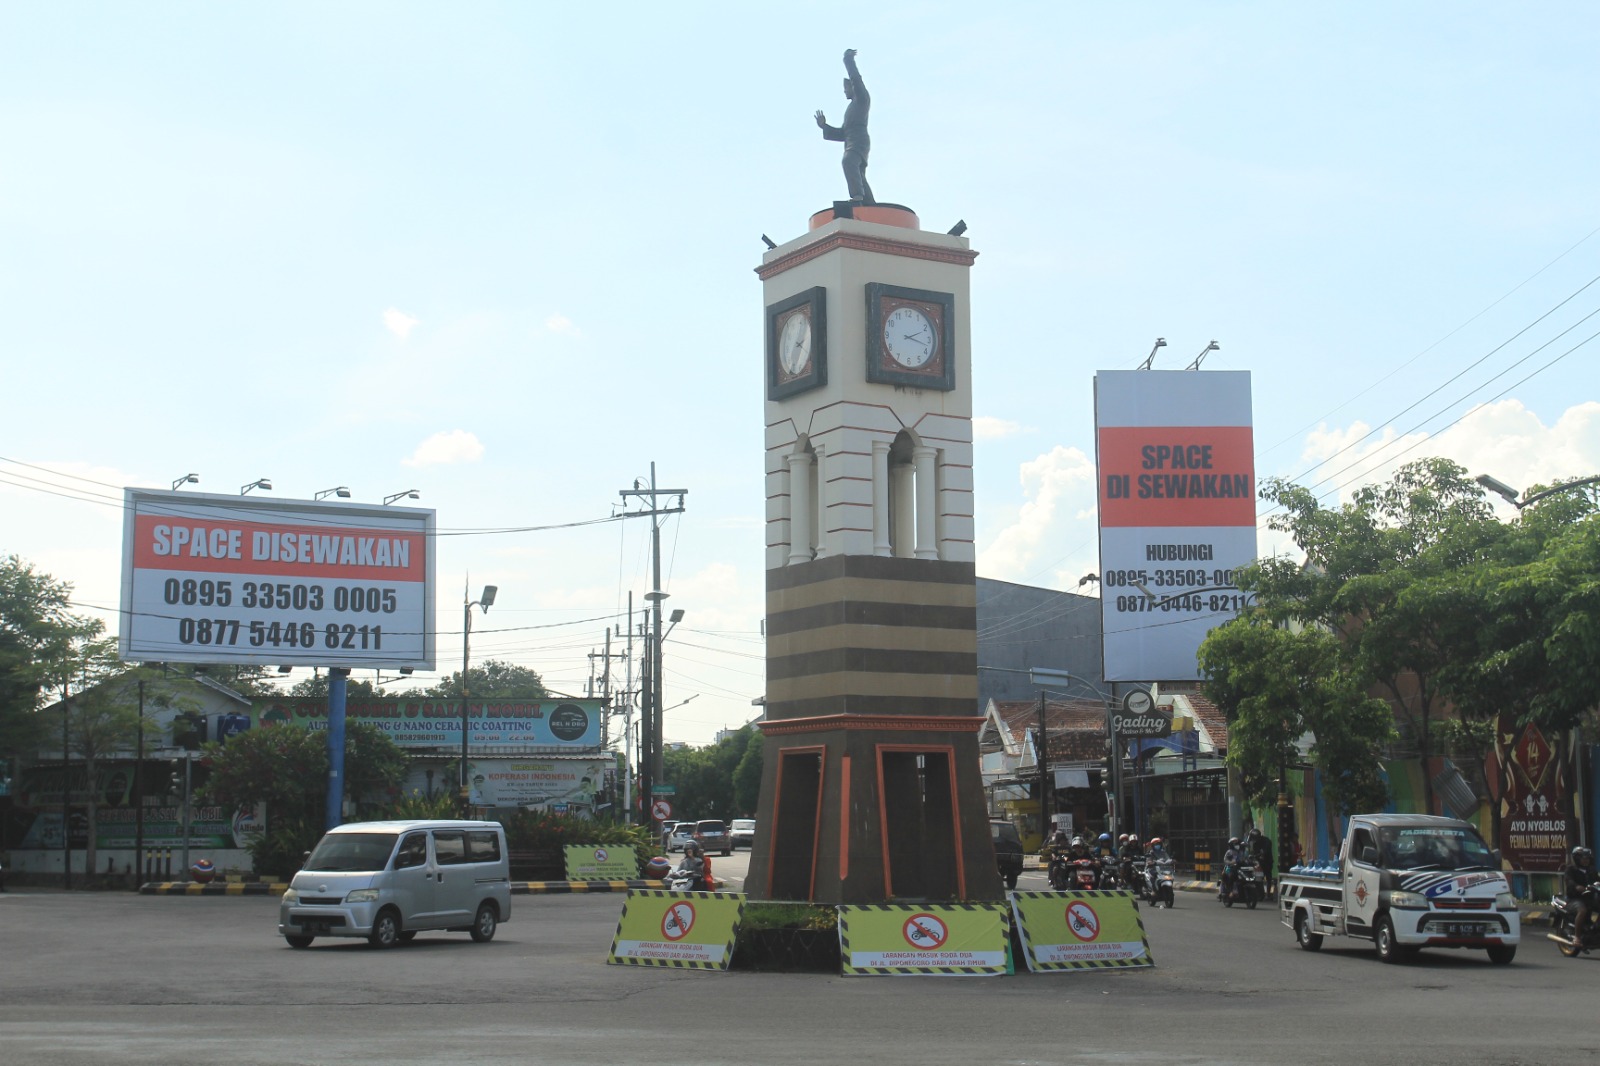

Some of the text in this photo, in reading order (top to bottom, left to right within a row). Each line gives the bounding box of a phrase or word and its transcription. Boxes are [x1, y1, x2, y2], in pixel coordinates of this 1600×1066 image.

[895, 312, 901, 320] 11
[904, 310, 912, 318] 12
[888, 319, 895, 328] 10
[923, 324, 928, 332] 2
[1141, 444, 1213, 470] SPACE
[1107, 474, 1249, 499] DI SEWAKAN
[152, 525, 410, 569] SPACE DISEWAKAN
[1146, 544, 1213, 561] HUBUNGI
[1106, 569, 1243, 587] 0895-33503-00
[164, 577, 396, 614] 0895 33503 0005
[1117, 595, 1246, 612] 08775446-8211
[179, 617, 381, 650] 0877 5446 8211
[296, 702, 329, 718] CUC
[422, 703, 483, 718] SALON
[486, 703, 545, 718] MOBIL
[308, 721, 329, 730] AUT
[403, 721, 432, 730] NANO
[434, 721, 480, 731] CERAIC
[482, 721, 532, 731] COATTING
[1113, 715, 1167, 733] Gading
[1527, 741, 1539, 765] 14
[1510, 820, 1566, 832] AYO NYOBLOS
[1531, 835, 1550, 849] TAHUN
[1550, 835, 1567, 849] 2024
